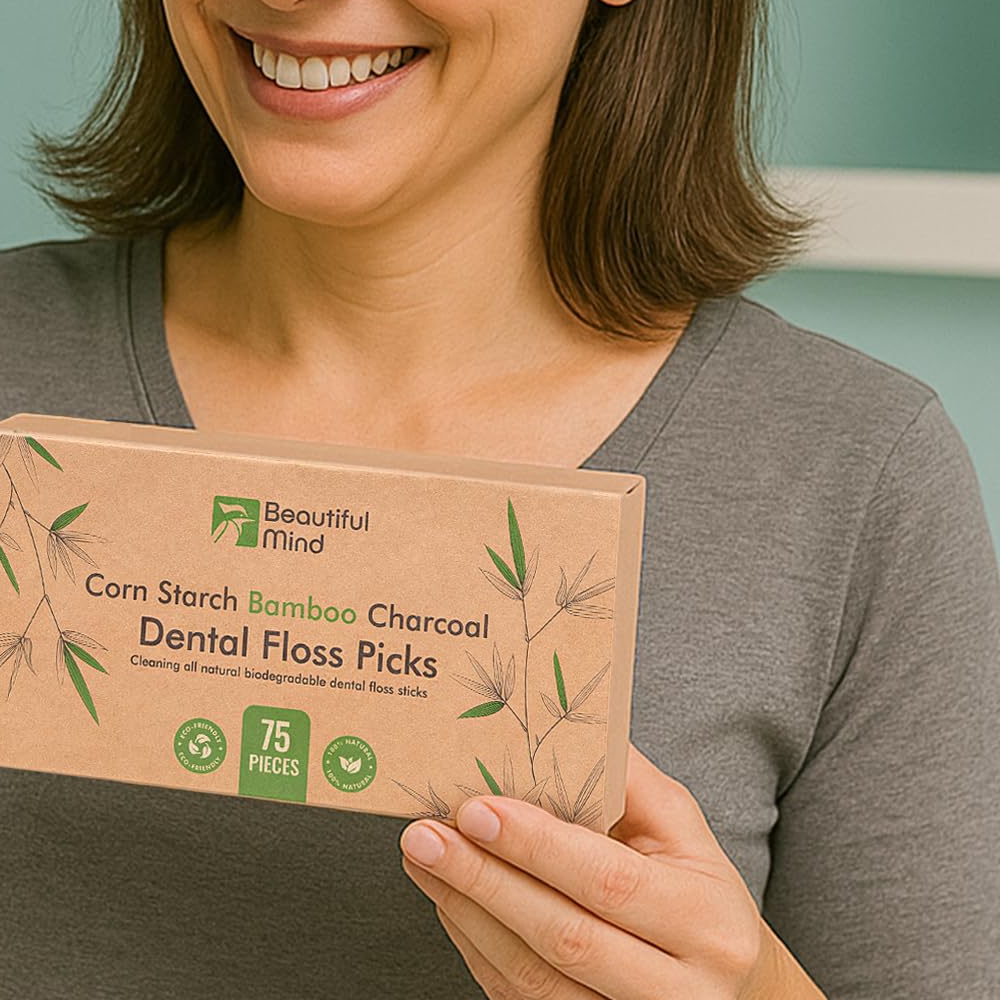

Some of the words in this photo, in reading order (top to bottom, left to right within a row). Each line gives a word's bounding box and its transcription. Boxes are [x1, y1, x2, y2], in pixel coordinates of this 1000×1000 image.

[264, 501, 369, 531] Beautiful
[262, 528, 325, 554] Mind
[85, 572, 147, 602] Corn
[157, 580, 238, 612] Starch
[248, 590, 357, 625] Bamboo
[368, 603, 489, 638] Charcoal
[139, 616, 249, 657] Dental
[262, 629, 344, 668] Floss
[357, 640, 438, 678] Picks
[130, 654, 180, 673] Cleaning
[183, 660, 198, 673] all
[200, 664, 241, 677] natural
[244, 668, 327, 688] biodegradable
[329, 676, 366, 692] dental
[369, 681, 395, 695] floss
[397, 685, 429, 699] sticks
[180, 722, 222, 744] ECO-FRIENDLY
[260, 718, 291, 753] 75
[178, 751, 221, 772] ECO-FRIENDLY
[345, 739, 373, 761] NATURAL
[248, 753, 300, 777] PIECES
[342, 774, 373, 790] NATURAL
